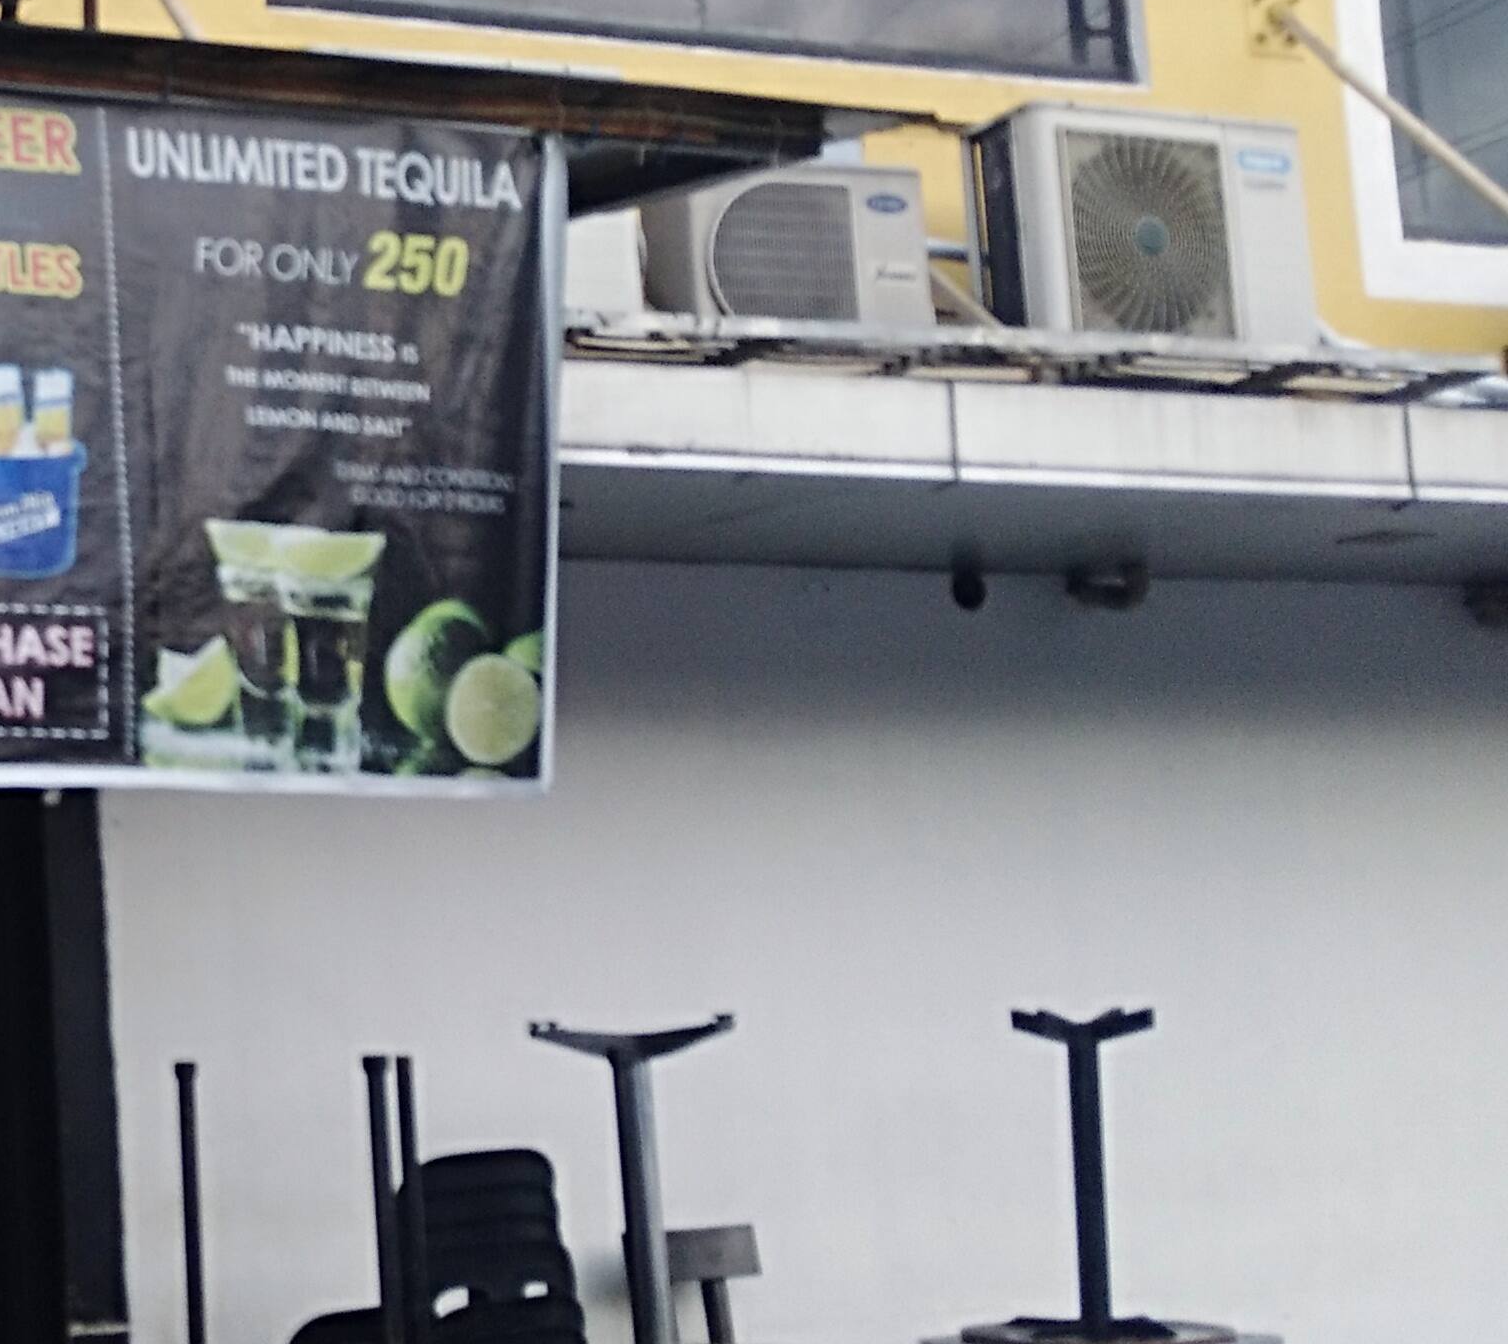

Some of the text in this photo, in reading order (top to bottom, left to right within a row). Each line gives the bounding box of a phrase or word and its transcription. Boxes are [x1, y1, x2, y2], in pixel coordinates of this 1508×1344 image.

[126, 126, 522, 211] UNLIMITED TEQUILA
[196, 230, 469, 298] FOR ONLY 250
[244, 405, 318, 429] LEMON
[321, 411, 362, 435] AND
